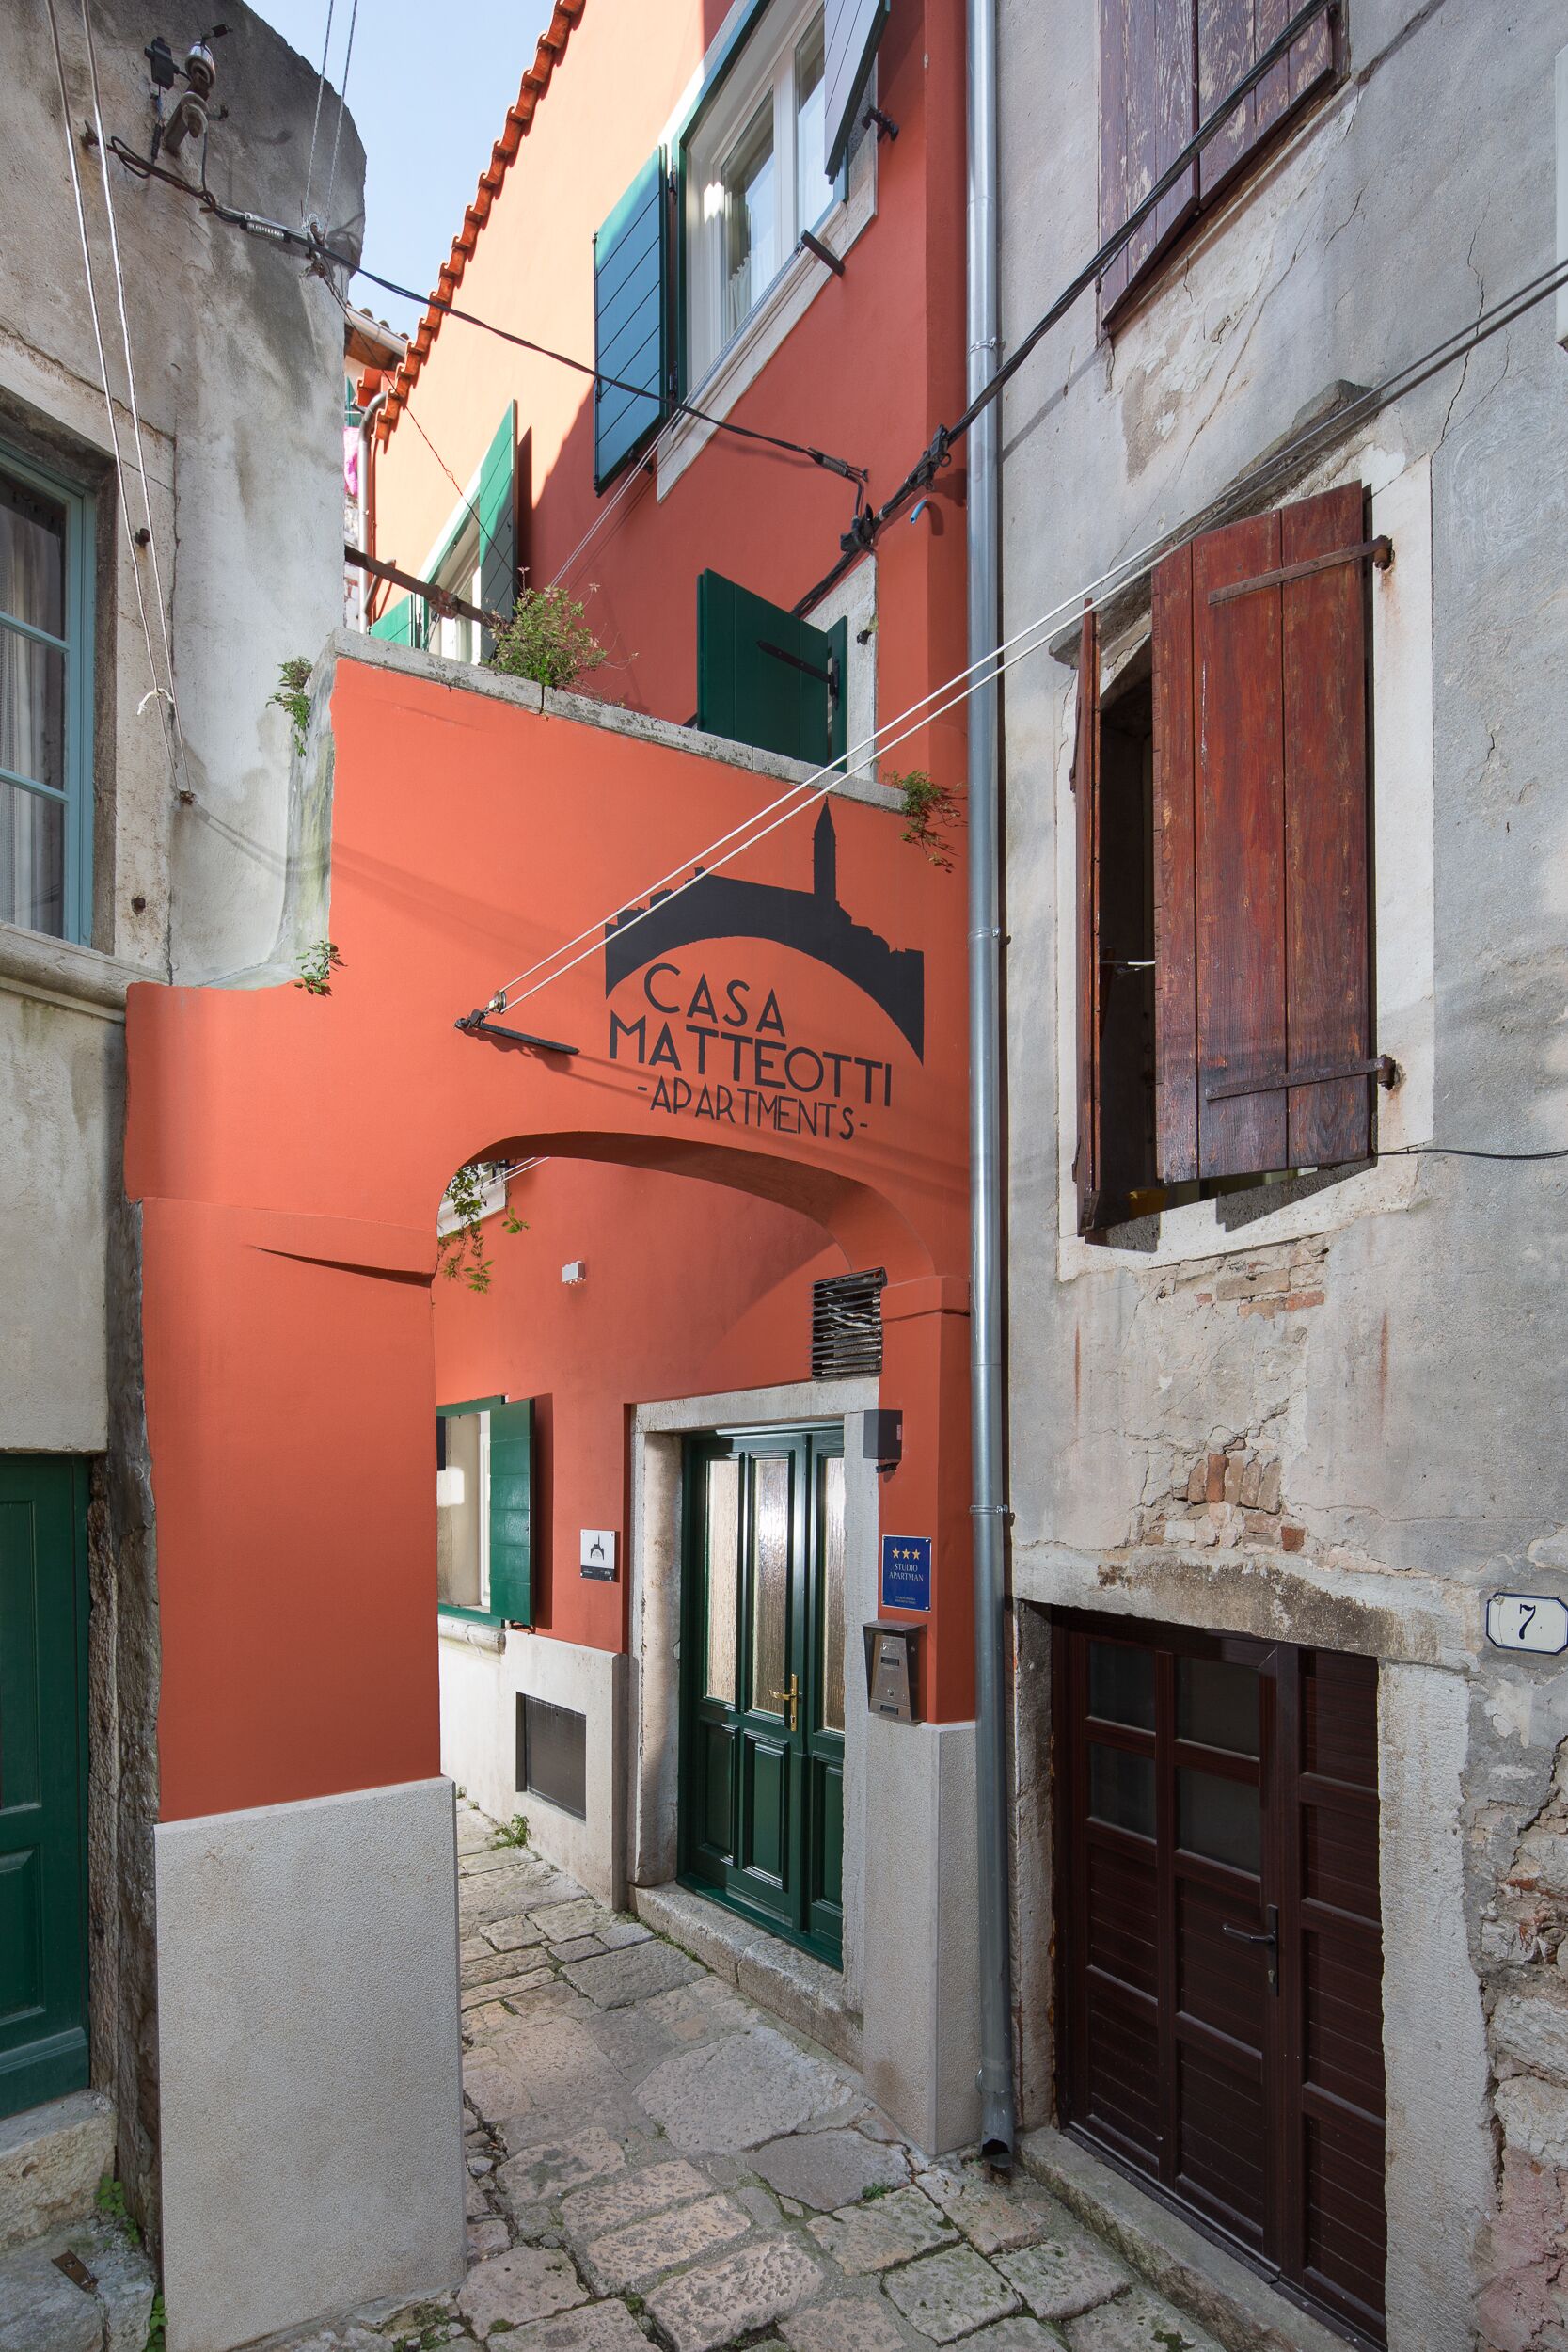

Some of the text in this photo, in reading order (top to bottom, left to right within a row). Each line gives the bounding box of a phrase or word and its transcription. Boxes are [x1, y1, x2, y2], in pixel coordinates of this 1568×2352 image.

[643, 962, 786, 1037] CASA
[609, 1009, 892, 1107] MATTEOTTI
[889, 1571, 924, 1581] APARTMAN
[894, 1563, 918, 1572] STUDIO
[1518, 1603, 1536, 1640] 7
